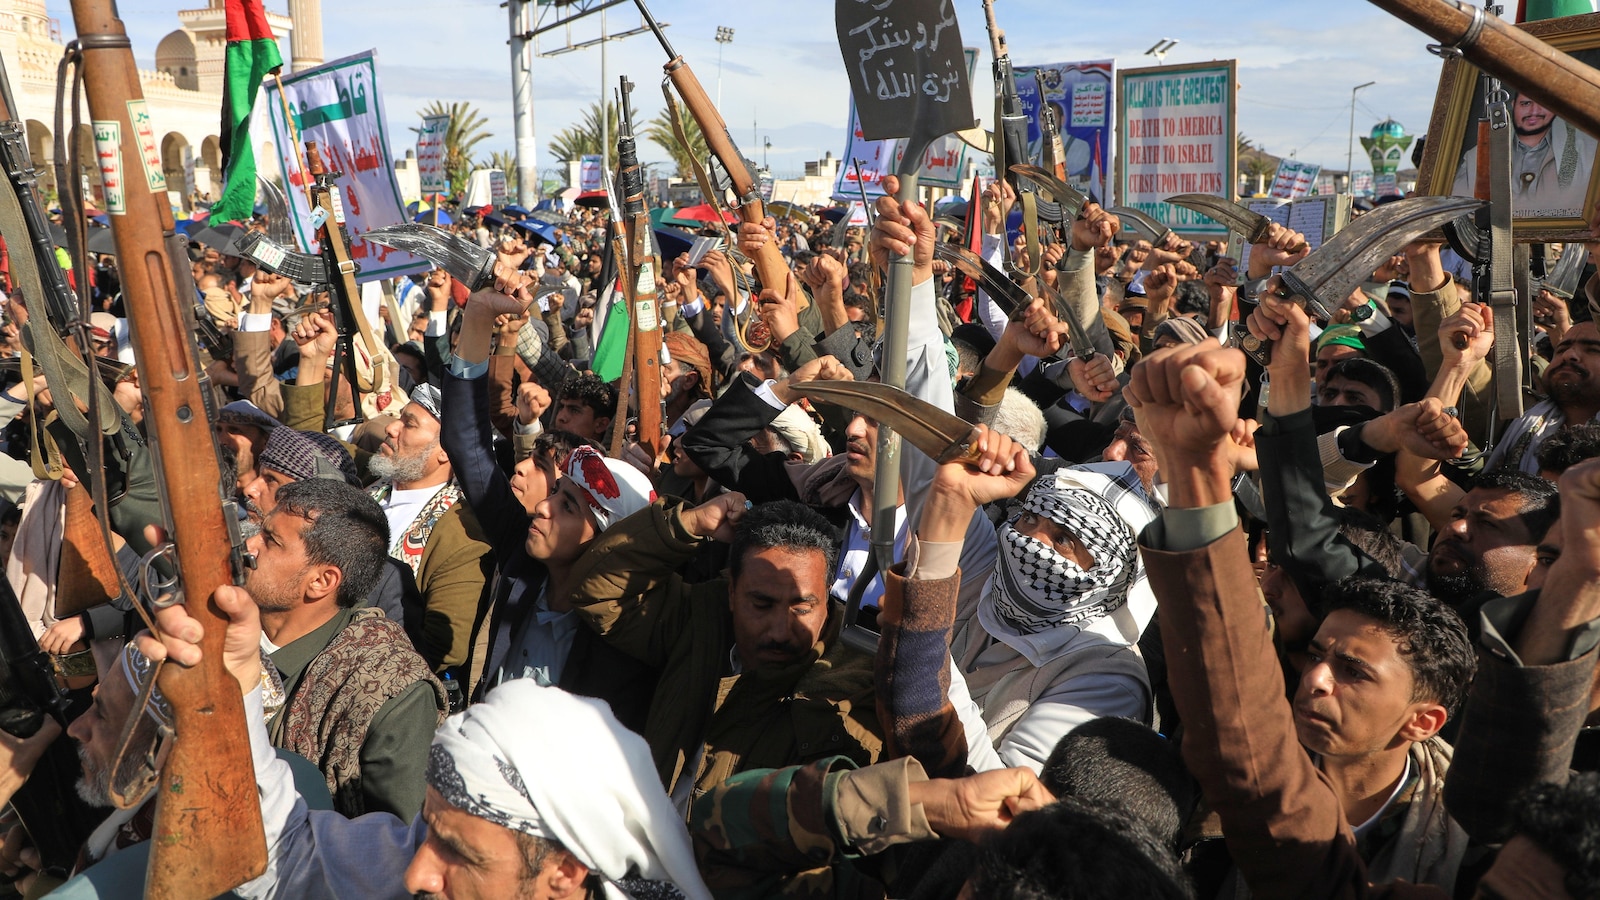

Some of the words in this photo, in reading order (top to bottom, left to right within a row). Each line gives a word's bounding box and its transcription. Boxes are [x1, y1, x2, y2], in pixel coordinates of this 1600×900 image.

[877, 58, 916, 100] الله
[1129, 81, 1153, 108] ALLAH
[1155, 80, 1164, 107] IS
[1165, 78, 1181, 106] THE
[1183, 75, 1226, 106] GREATEST
[1129, 118, 1160, 138] DEATH
[1163, 117, 1175, 137] TO
[1178, 115, 1223, 137] AMERICA
[1129, 145, 1160, 164] DEATH
[1163, 144, 1176, 164] TO
[1178, 144, 1214, 164] ISRAEL
[1129, 174, 1154, 193] CURSE
[1156, 173, 1178, 193] UPON
[1180, 173, 1197, 193] THE
[1199, 172, 1221, 193] JEWS
[1174, 204, 1188, 224] TO
